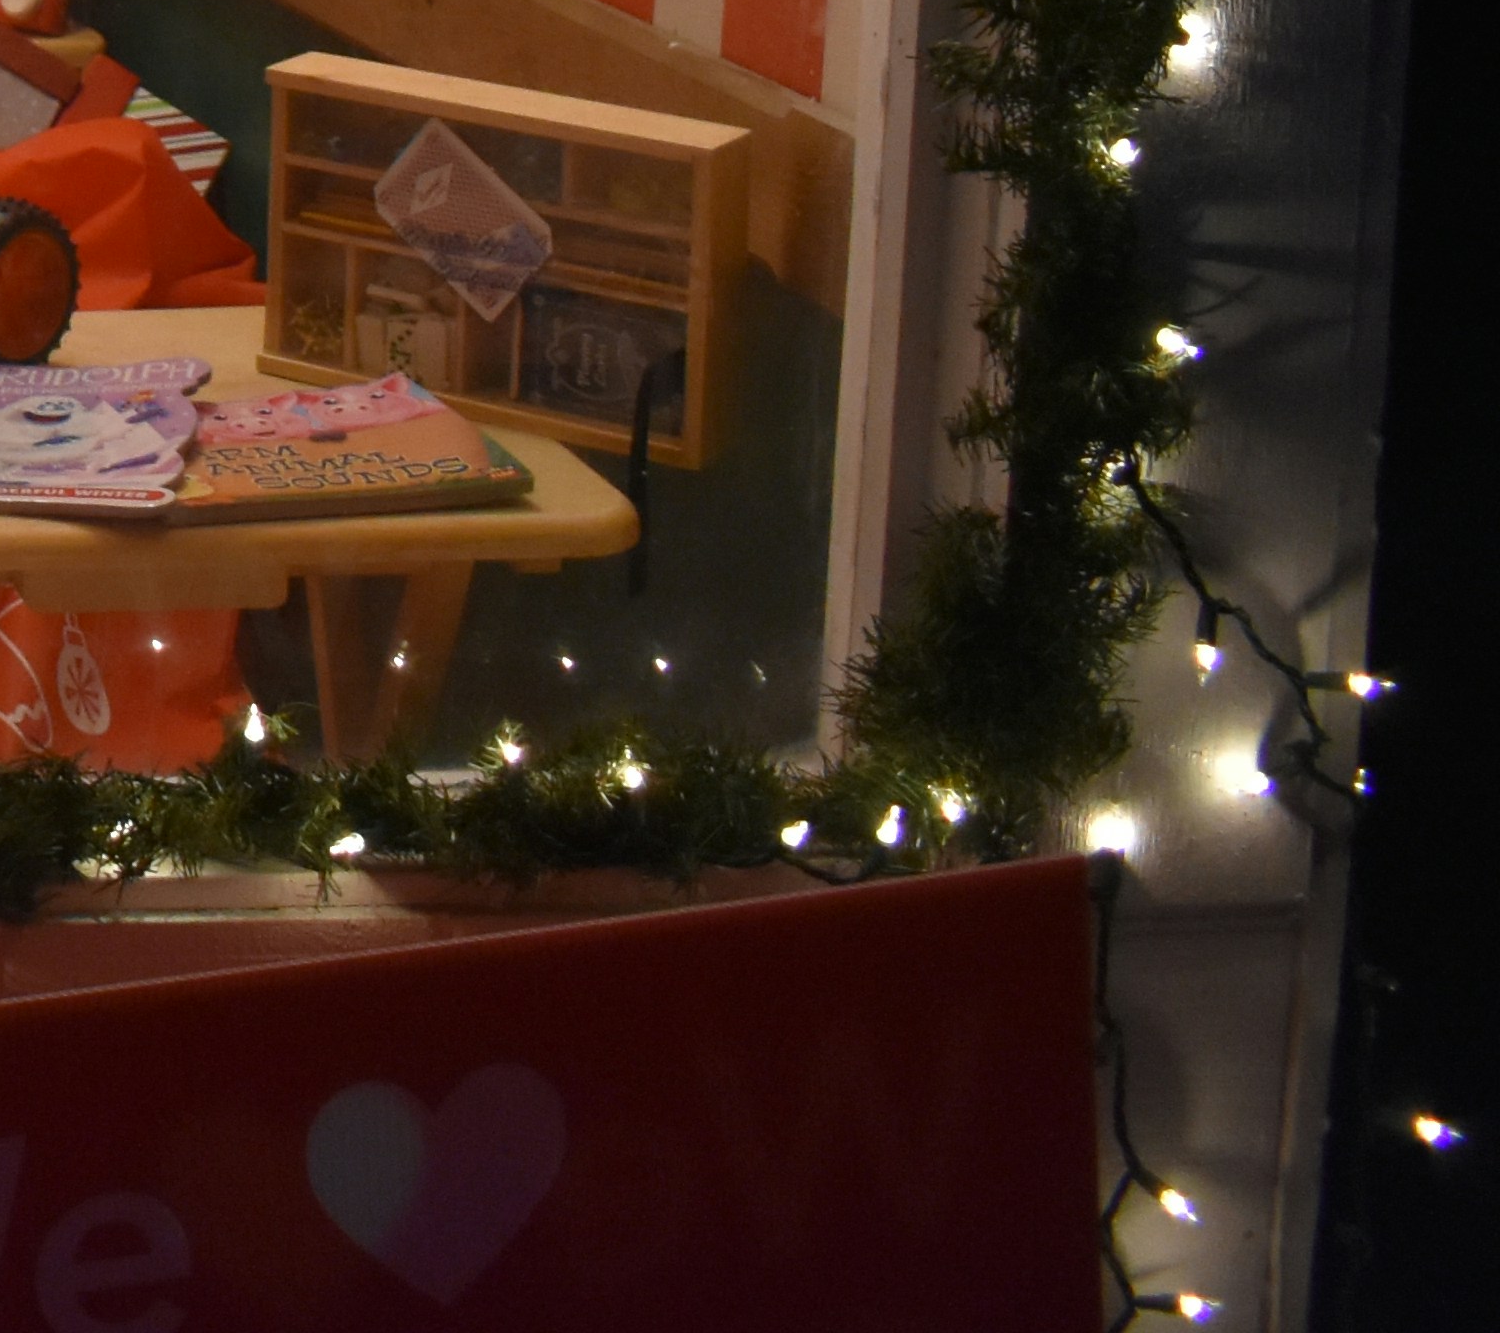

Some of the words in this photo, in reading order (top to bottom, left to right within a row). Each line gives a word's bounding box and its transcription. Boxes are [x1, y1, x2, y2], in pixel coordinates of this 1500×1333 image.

[201, 443, 301, 462] ARM
[207, 450, 407, 476] ANIMAL
[253, 456, 470, 490] SOUNDS
[74, 487, 151, 500] WINTER
